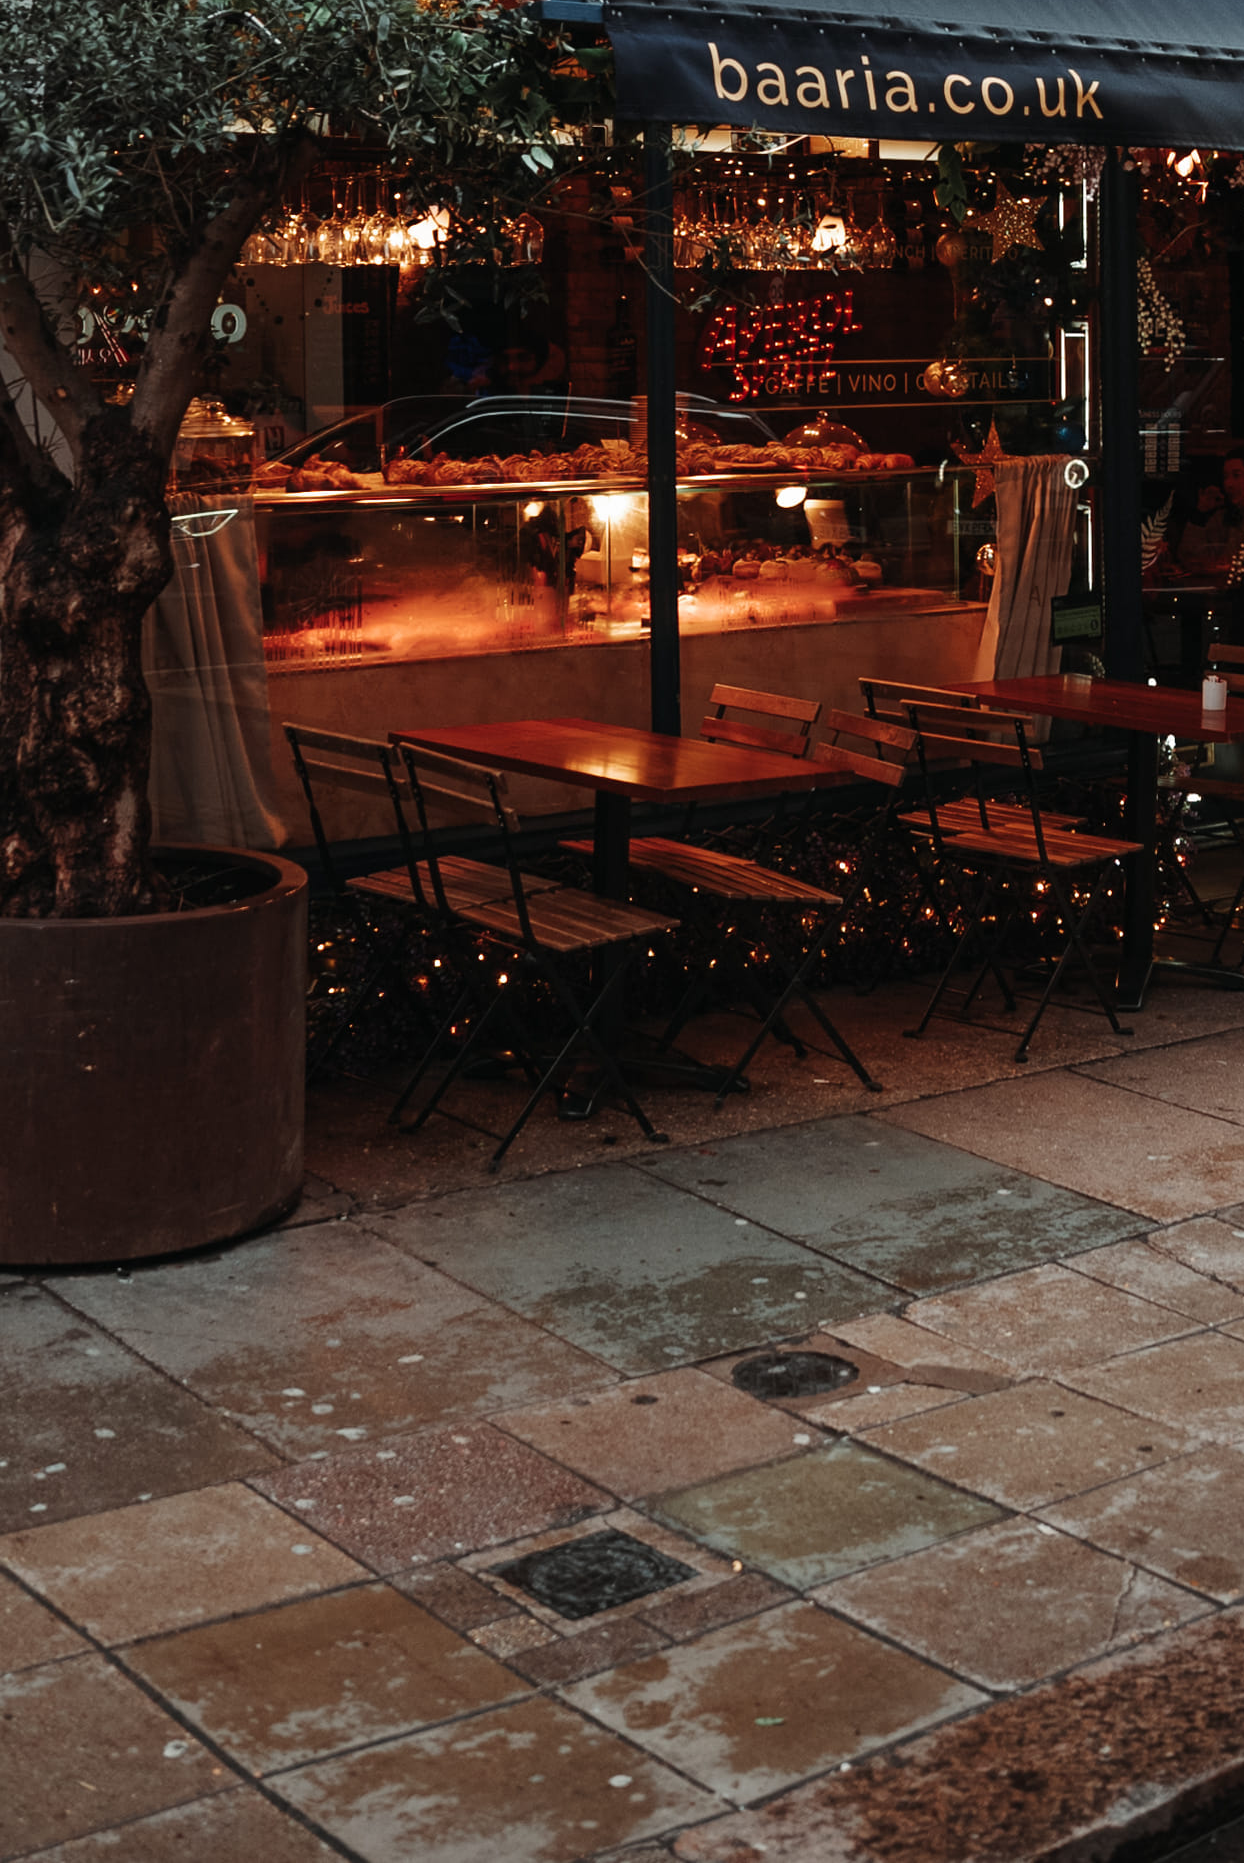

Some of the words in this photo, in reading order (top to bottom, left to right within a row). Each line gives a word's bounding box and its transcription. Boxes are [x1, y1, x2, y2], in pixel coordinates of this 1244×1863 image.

[709, 42, 1104, 120] baaria.co.uk
[848, 373, 897, 393] VINO
[915, 370, 1019, 392] CTAILS
